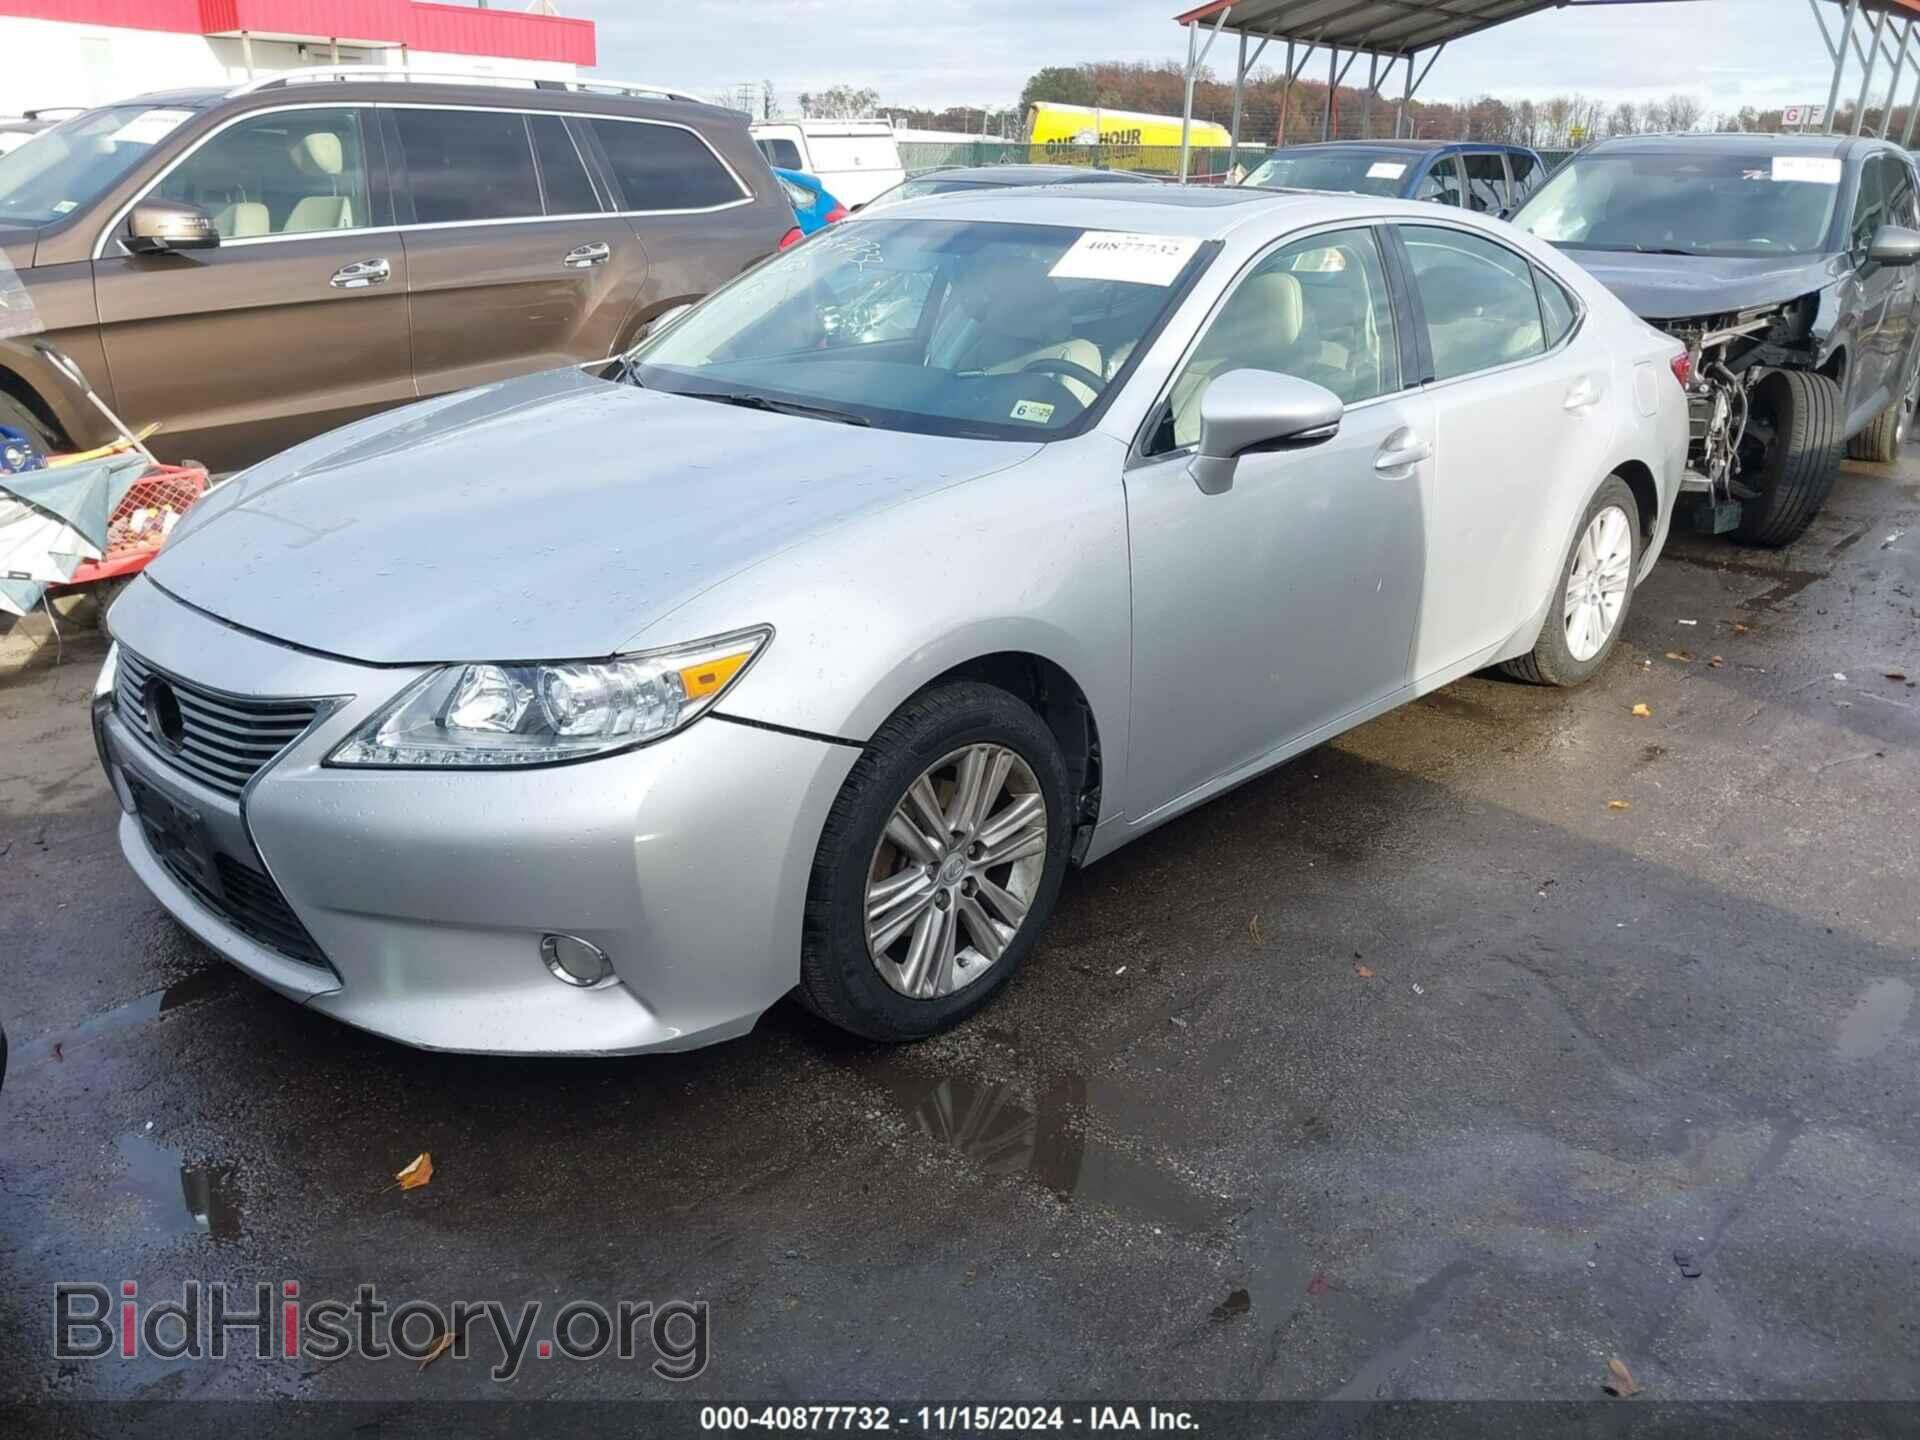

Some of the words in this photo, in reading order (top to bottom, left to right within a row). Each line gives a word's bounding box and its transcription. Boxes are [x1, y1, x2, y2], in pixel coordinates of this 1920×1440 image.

[1786, 109, 1798, 121] G
[1098, 129, 1142, 145] HOUR
[1017, 404, 1028, 416] 6
